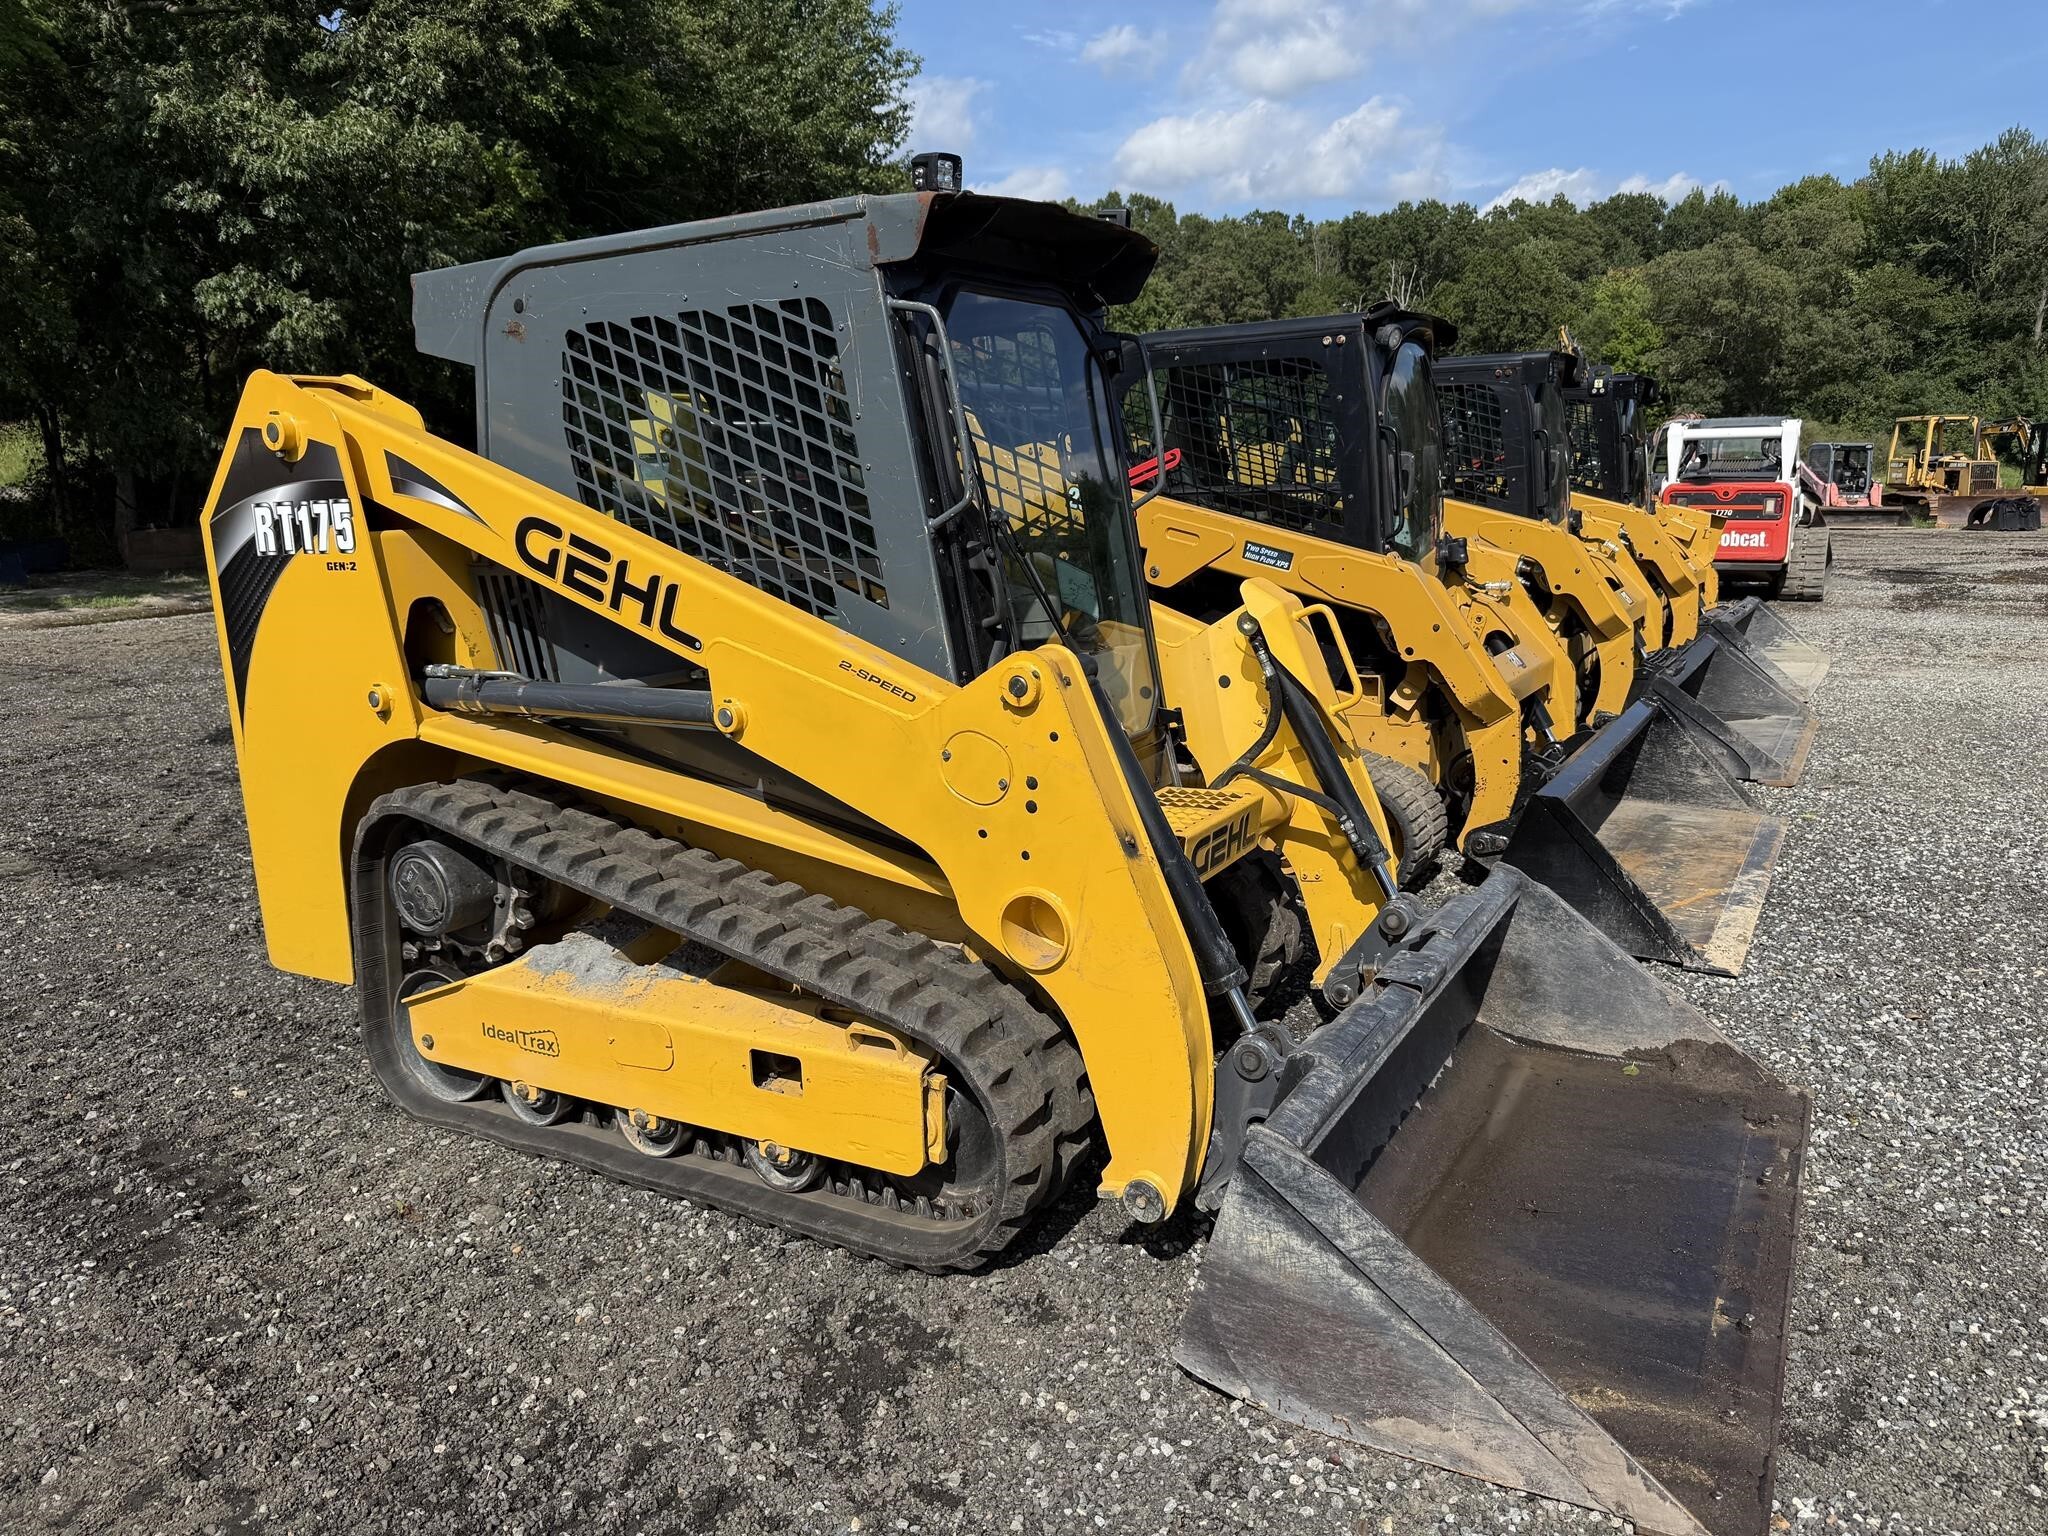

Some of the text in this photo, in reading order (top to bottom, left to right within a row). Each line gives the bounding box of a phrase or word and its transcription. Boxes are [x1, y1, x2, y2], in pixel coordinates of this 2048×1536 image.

[251, 498, 356, 556] RT175
[1719, 530, 1767, 547] obcat
[326, 561, 357, 571] GEN:2
[1260, 547, 1279, 558] SPEED
[1260, 555, 1276, 565] FLOW
[1275, 559, 1290, 569] XPS
[515, 516, 703, 651] GEHL
[839, 660, 917, 702] 2-SPEED
[1191, 811, 1256, 876] GEHL
[481, 1021, 557, 1053] IdealTrax
